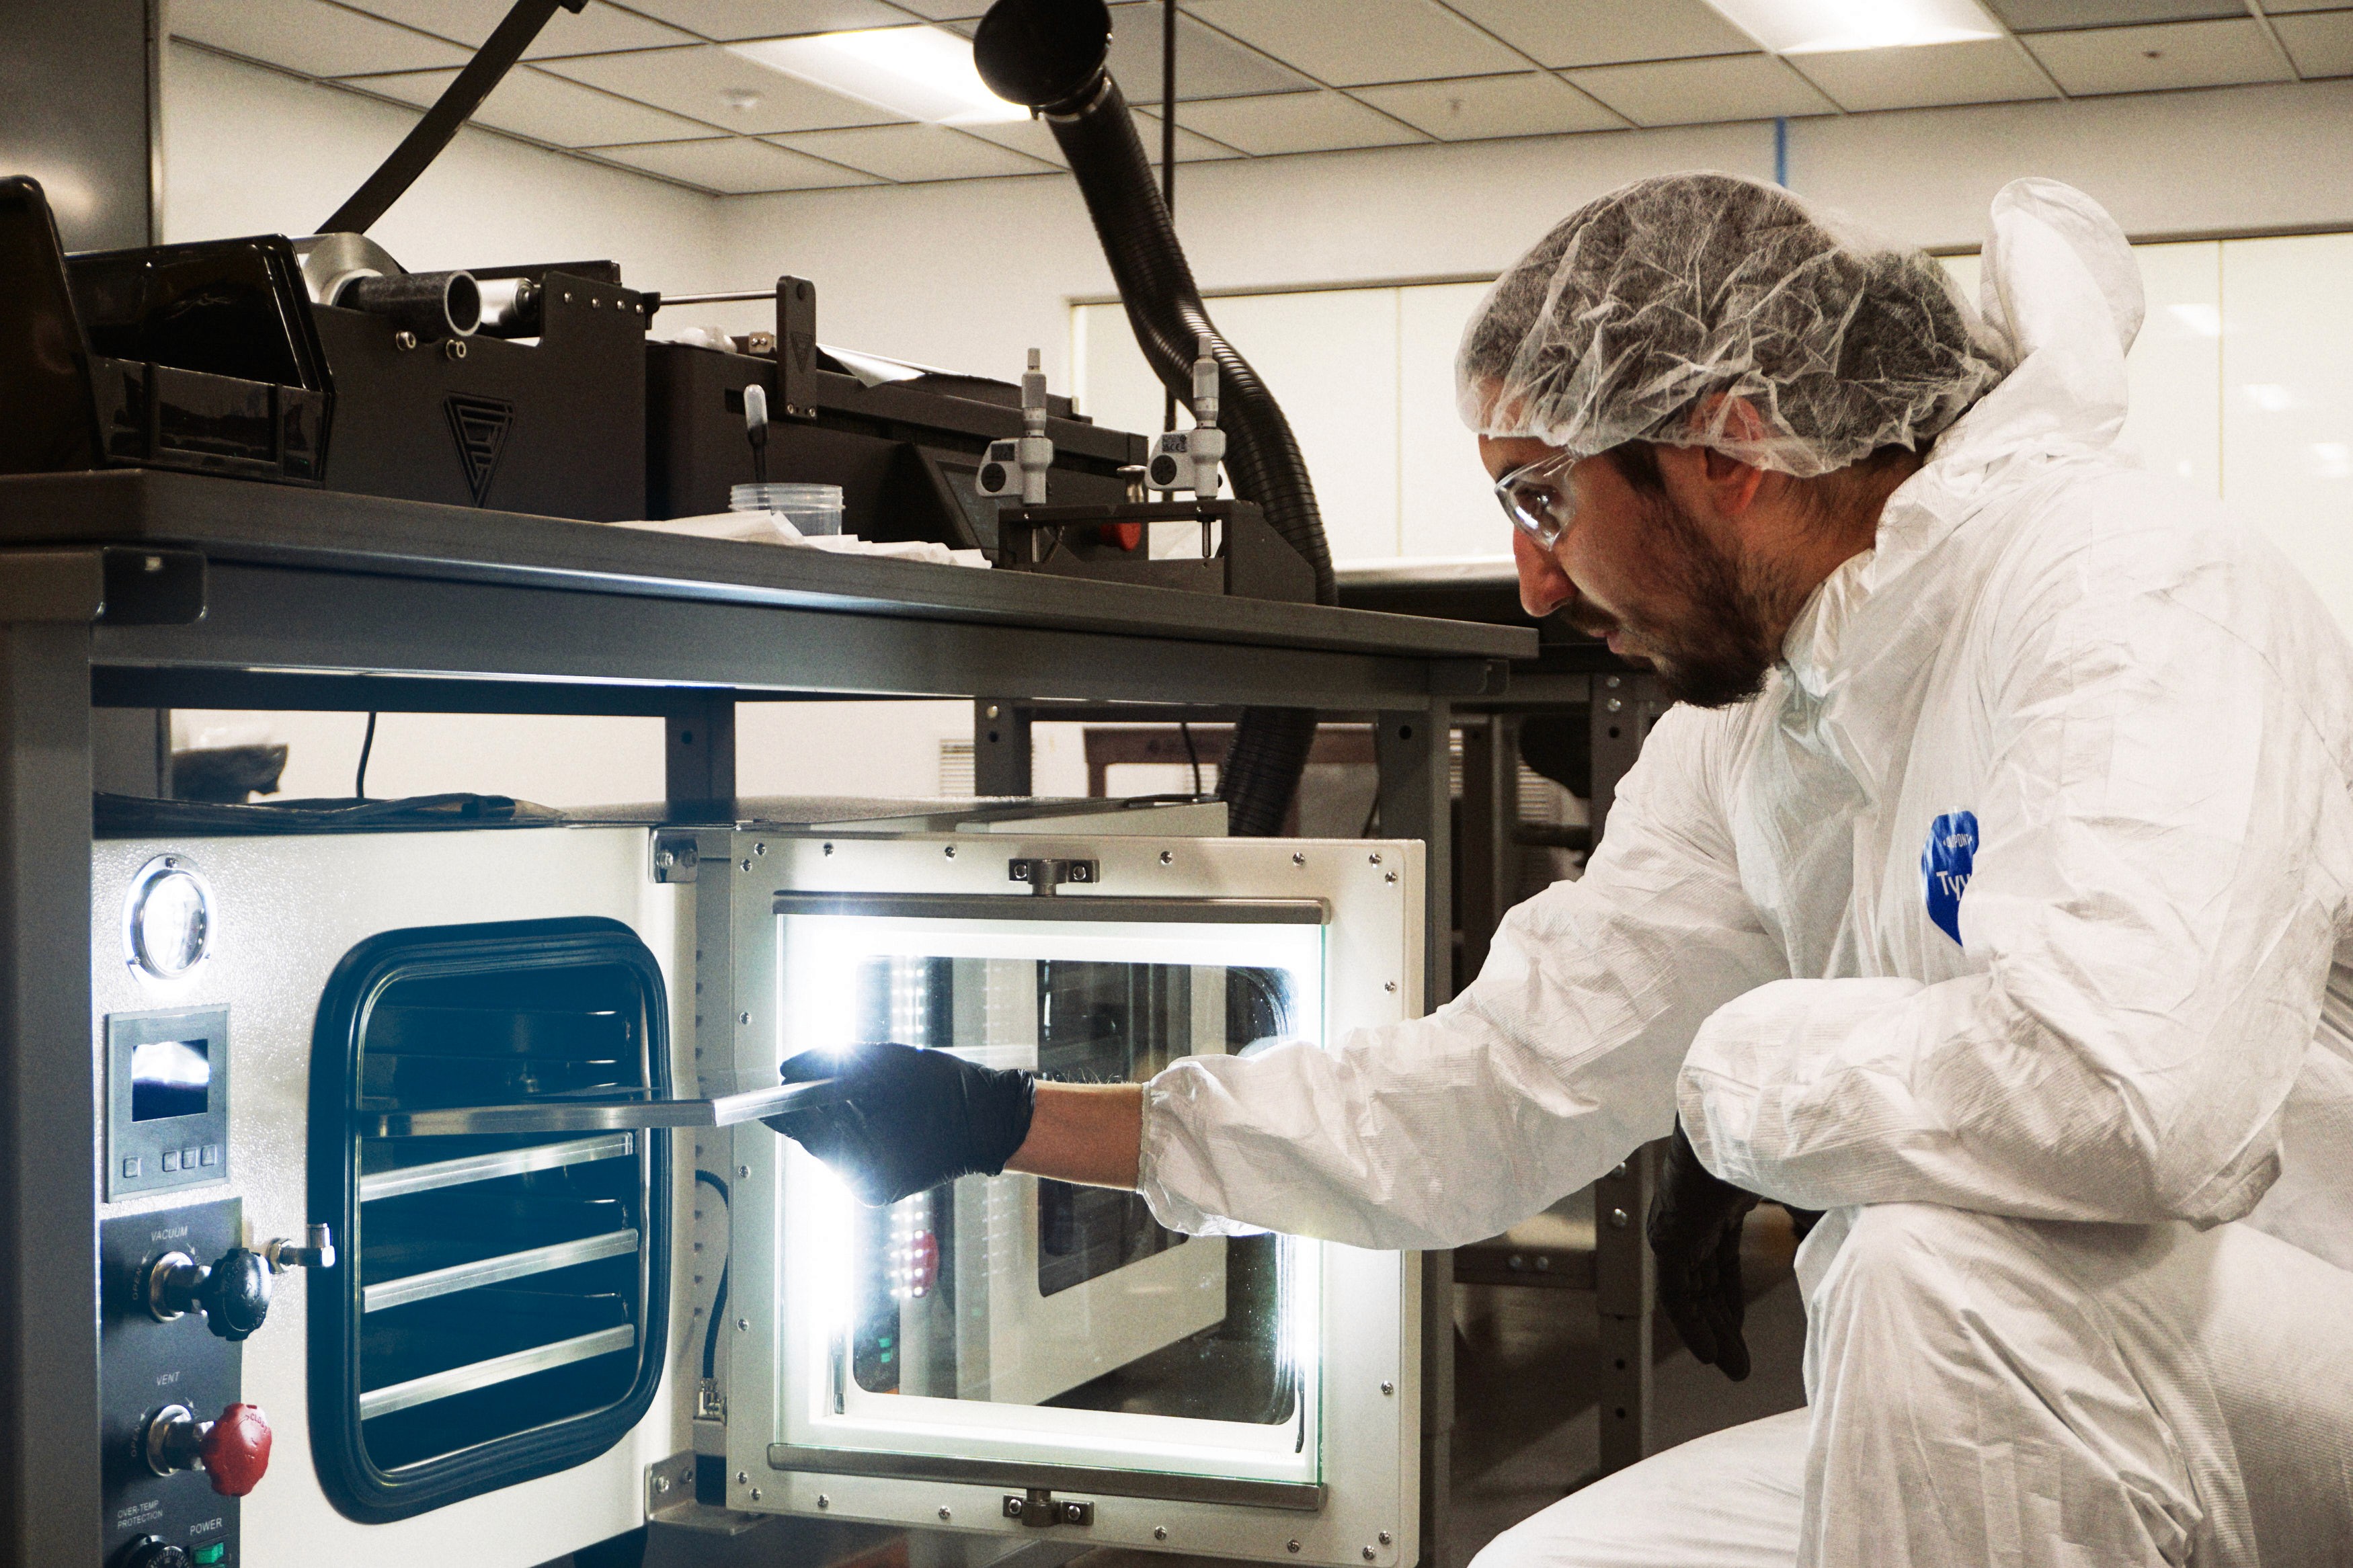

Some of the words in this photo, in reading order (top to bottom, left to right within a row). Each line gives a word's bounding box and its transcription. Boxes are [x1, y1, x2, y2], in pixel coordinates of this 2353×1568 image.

[151, 1226, 188, 1241] VACUUM
[157, 1371, 180, 1386] VENT
[117, 1499, 159, 1519] OVER-TEMP
[117, 1510, 163, 1530] PROTECTION
[190, 1518, 223, 1536] POWER
